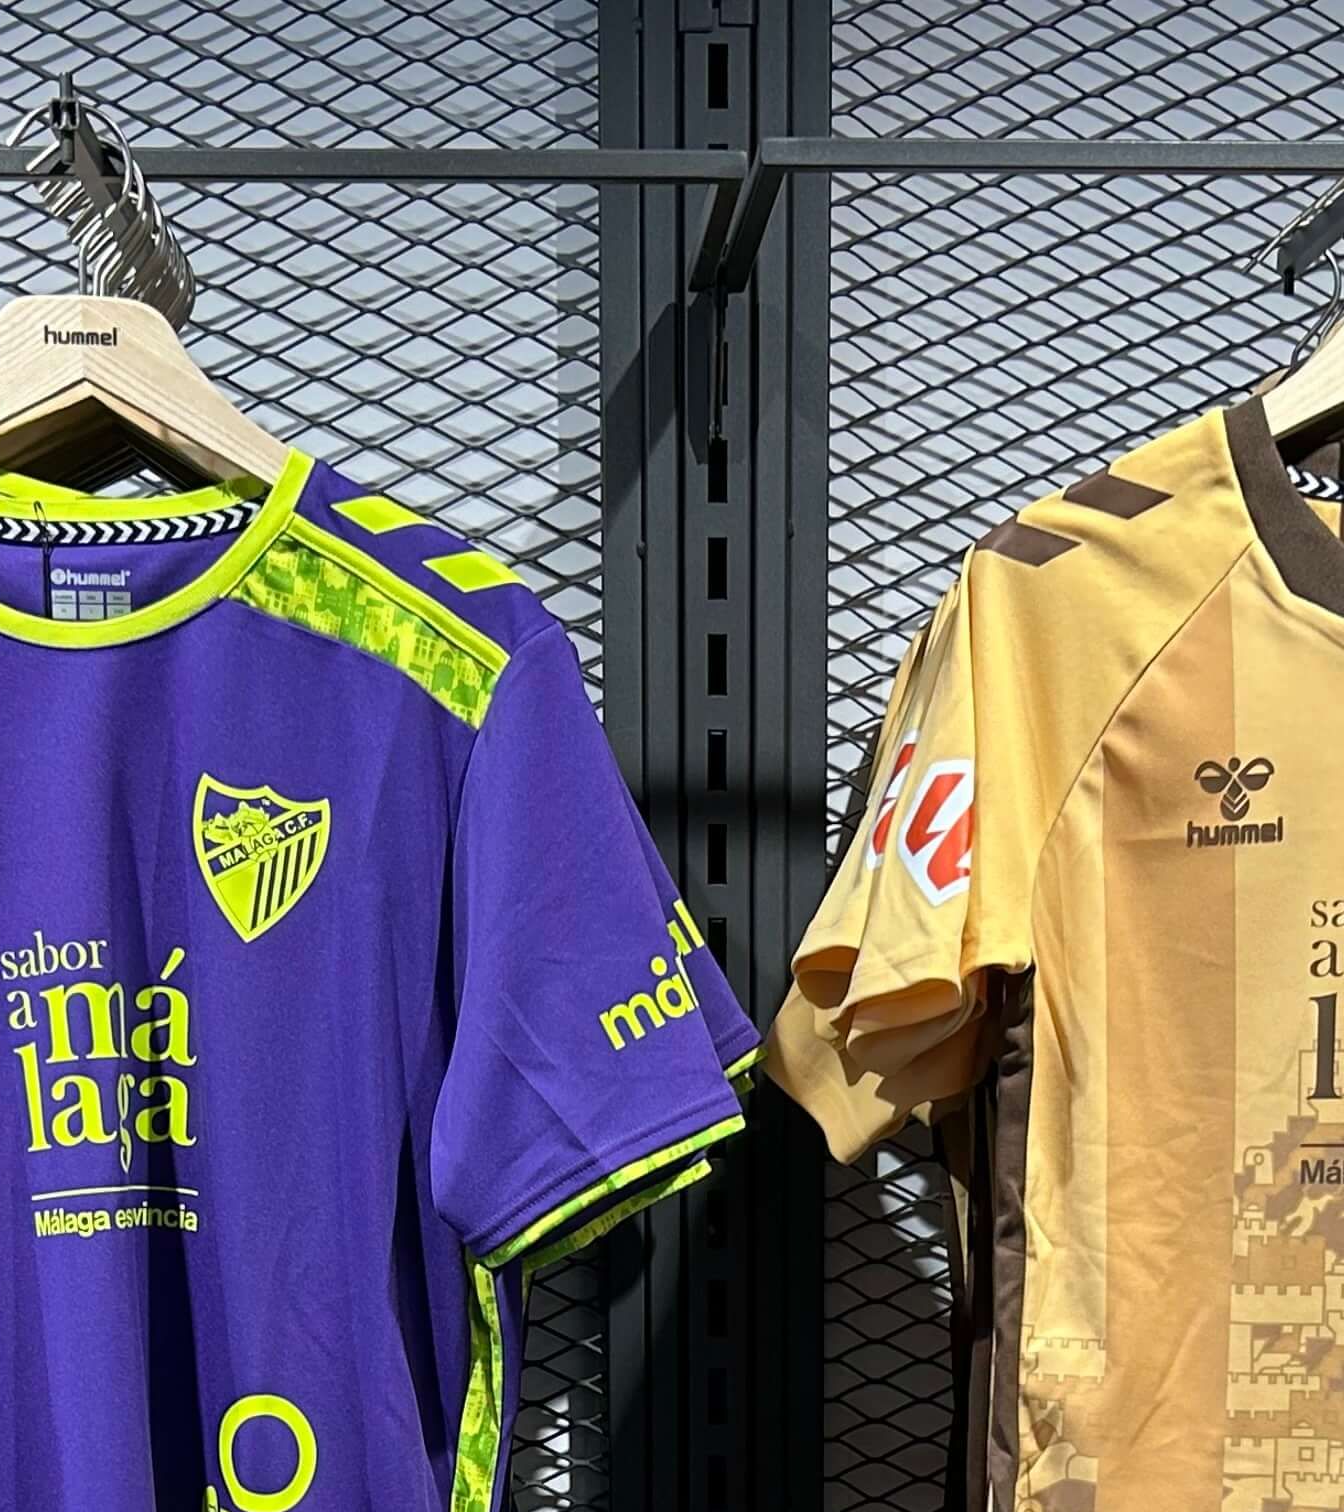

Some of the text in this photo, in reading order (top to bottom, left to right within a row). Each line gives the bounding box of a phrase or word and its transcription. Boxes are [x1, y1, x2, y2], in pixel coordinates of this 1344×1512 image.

[43, 325, 118, 347] hummel
[66, 568, 126, 587] hummel
[1186, 816, 1284, 847] hummel
[0, 930, 108, 981] sabor
[1309, 939, 1344, 978] a
[7, 946, 197, 1067] a má
[34, 1208, 112, 1238] Málaga
